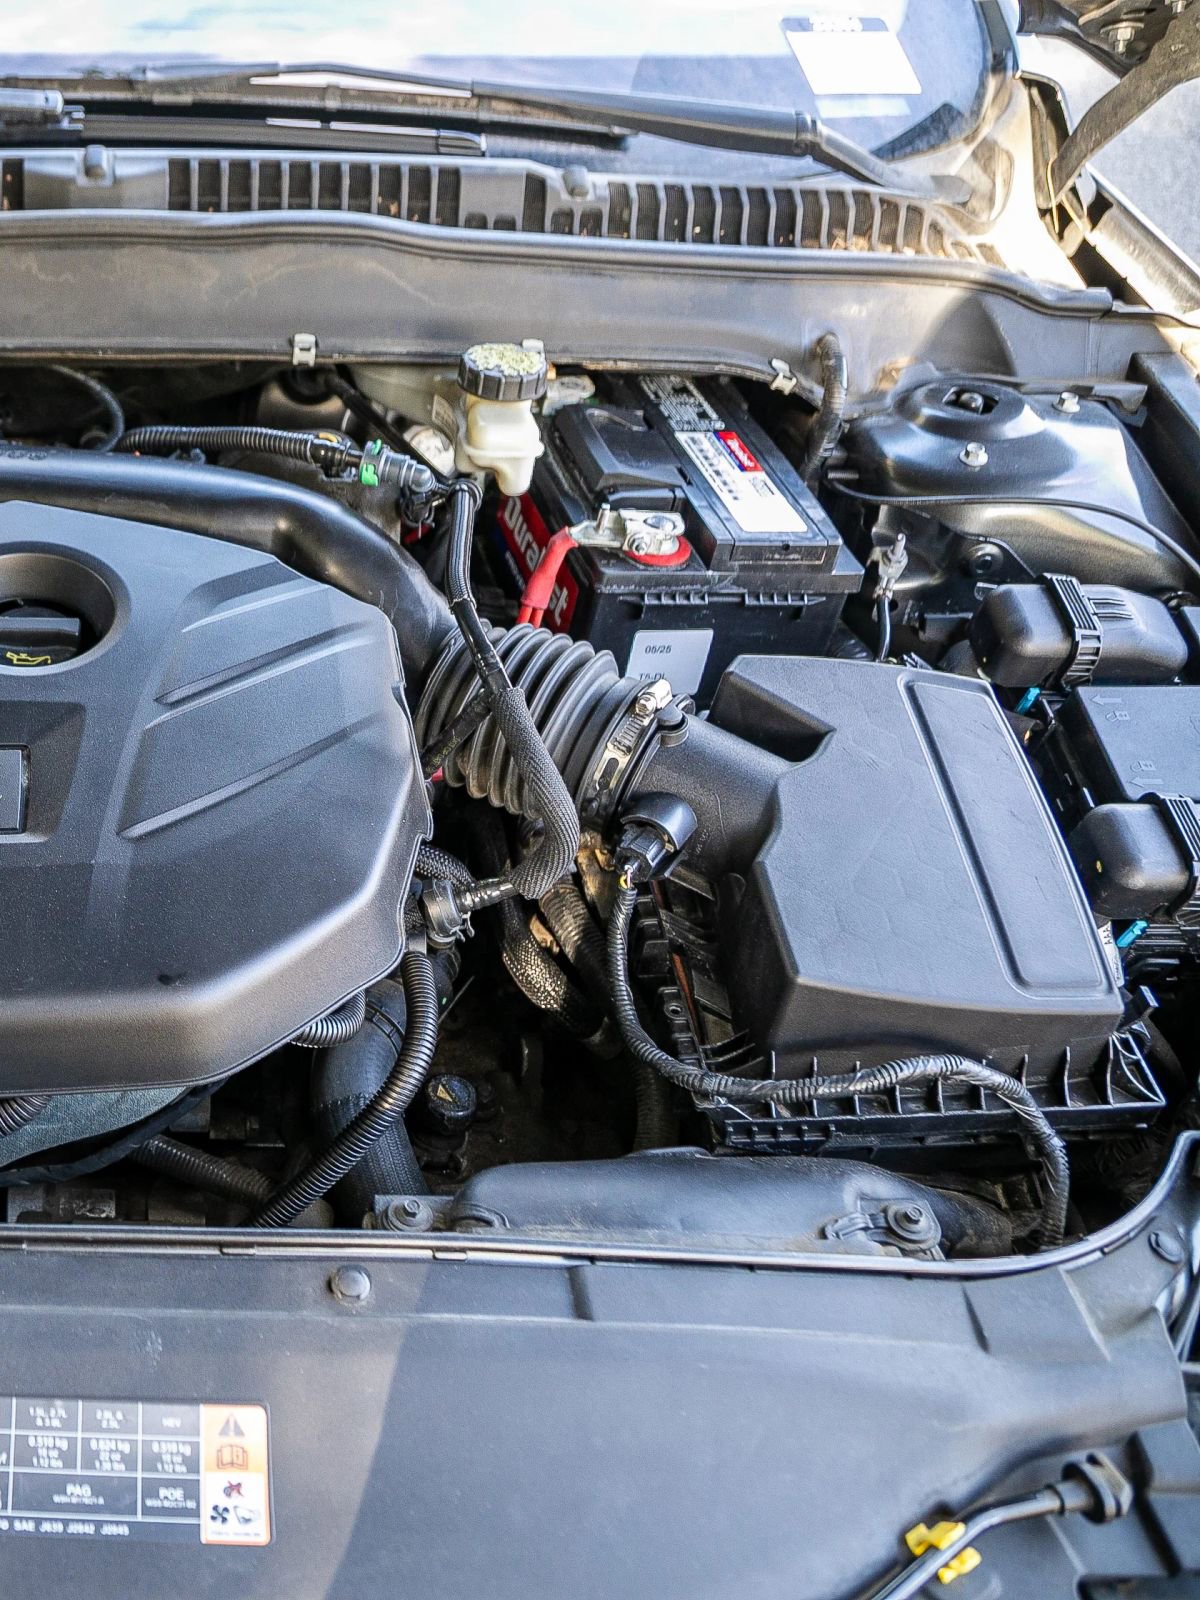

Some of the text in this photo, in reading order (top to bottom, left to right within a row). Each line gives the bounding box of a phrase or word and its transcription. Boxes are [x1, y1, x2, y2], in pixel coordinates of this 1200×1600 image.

[66, 1482, 91, 1496] PAG
[159, 1486, 184, 1500] POE
[14, 1520, 36, 1532] SAE
